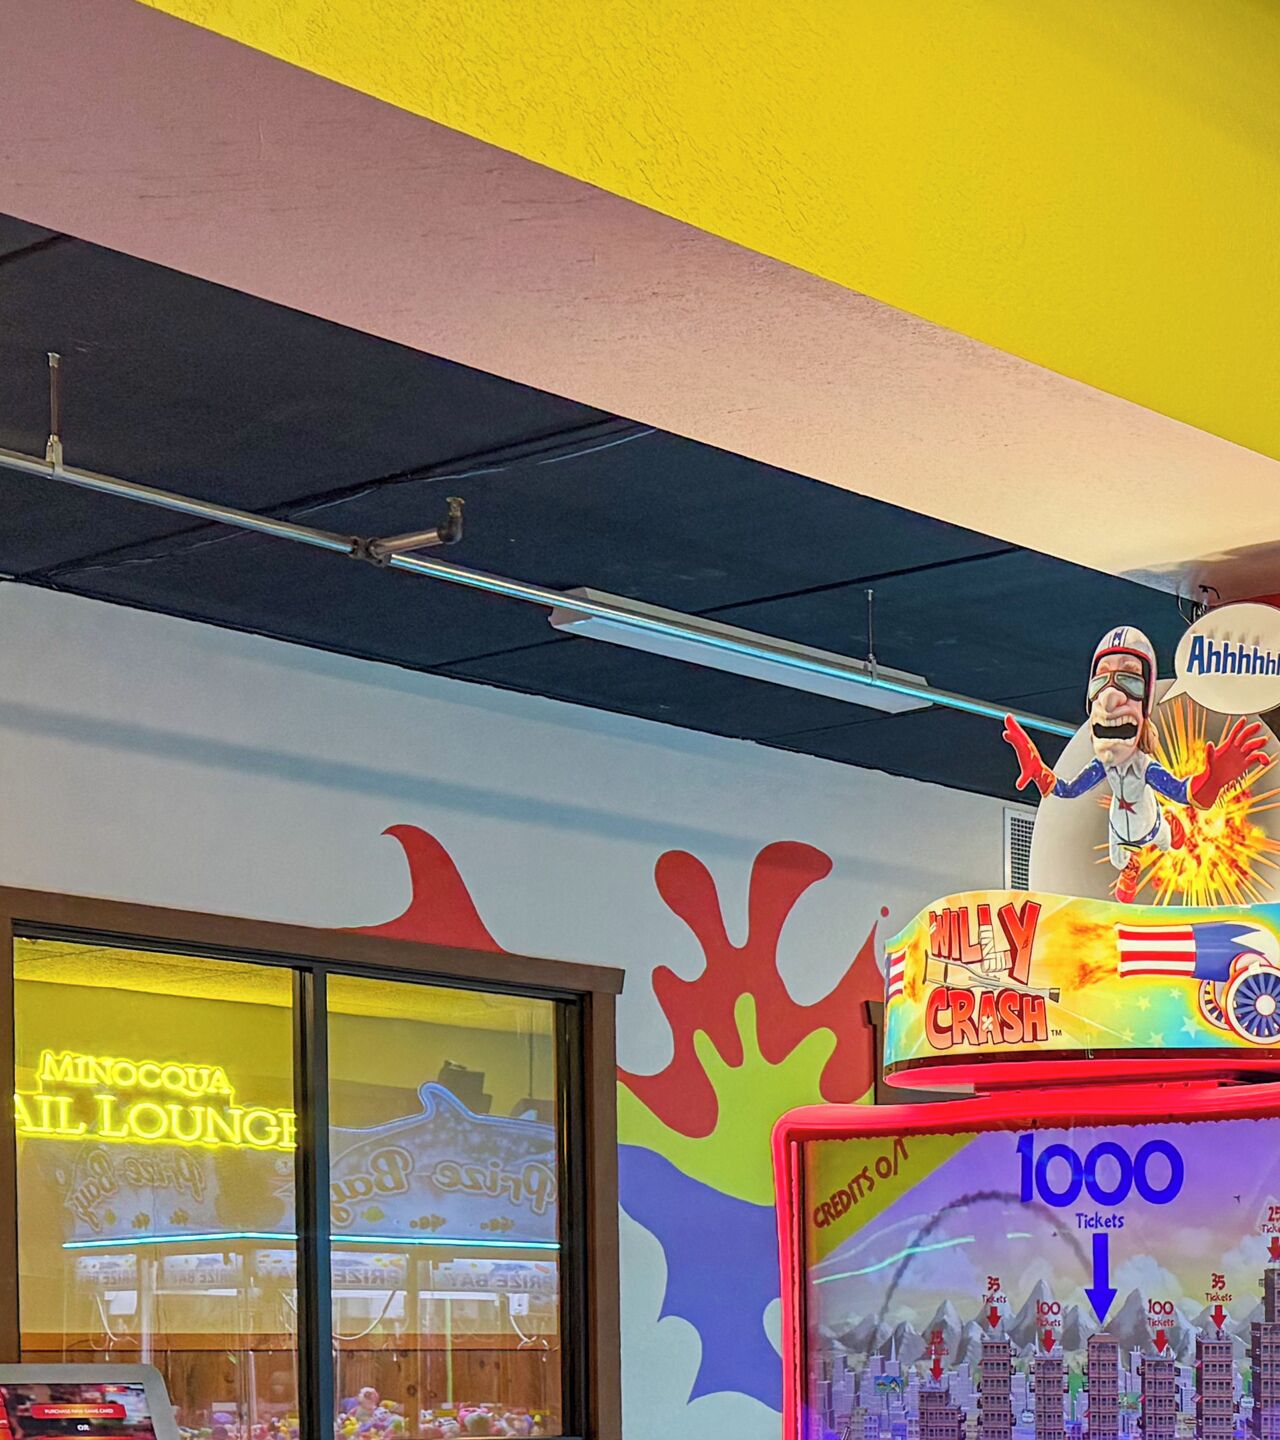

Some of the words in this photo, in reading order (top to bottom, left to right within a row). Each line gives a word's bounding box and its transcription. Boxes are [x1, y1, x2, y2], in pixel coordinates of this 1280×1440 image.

[929, 901, 1041, 985] WILLY
[925, 989, 1048, 1048] CRASH
[41, 1052, 231, 1097] MINOCQUA
[94, 1094, 297, 1148] LOUNGE
[1016, 1134, 1184, 1205] 1000
[813, 1166, 877, 1230] CREDITS
[1075, 1211, 1125, 1229] Tickets
[1205, 1292, 1233, 1302] Tickets
[1211, 1273, 1226, 1290] 35
[1036, 1300, 1061, 1316] 100
[1147, 1317, 1174, 1327] Tickets
[1148, 1299, 1174, 1315] 100
